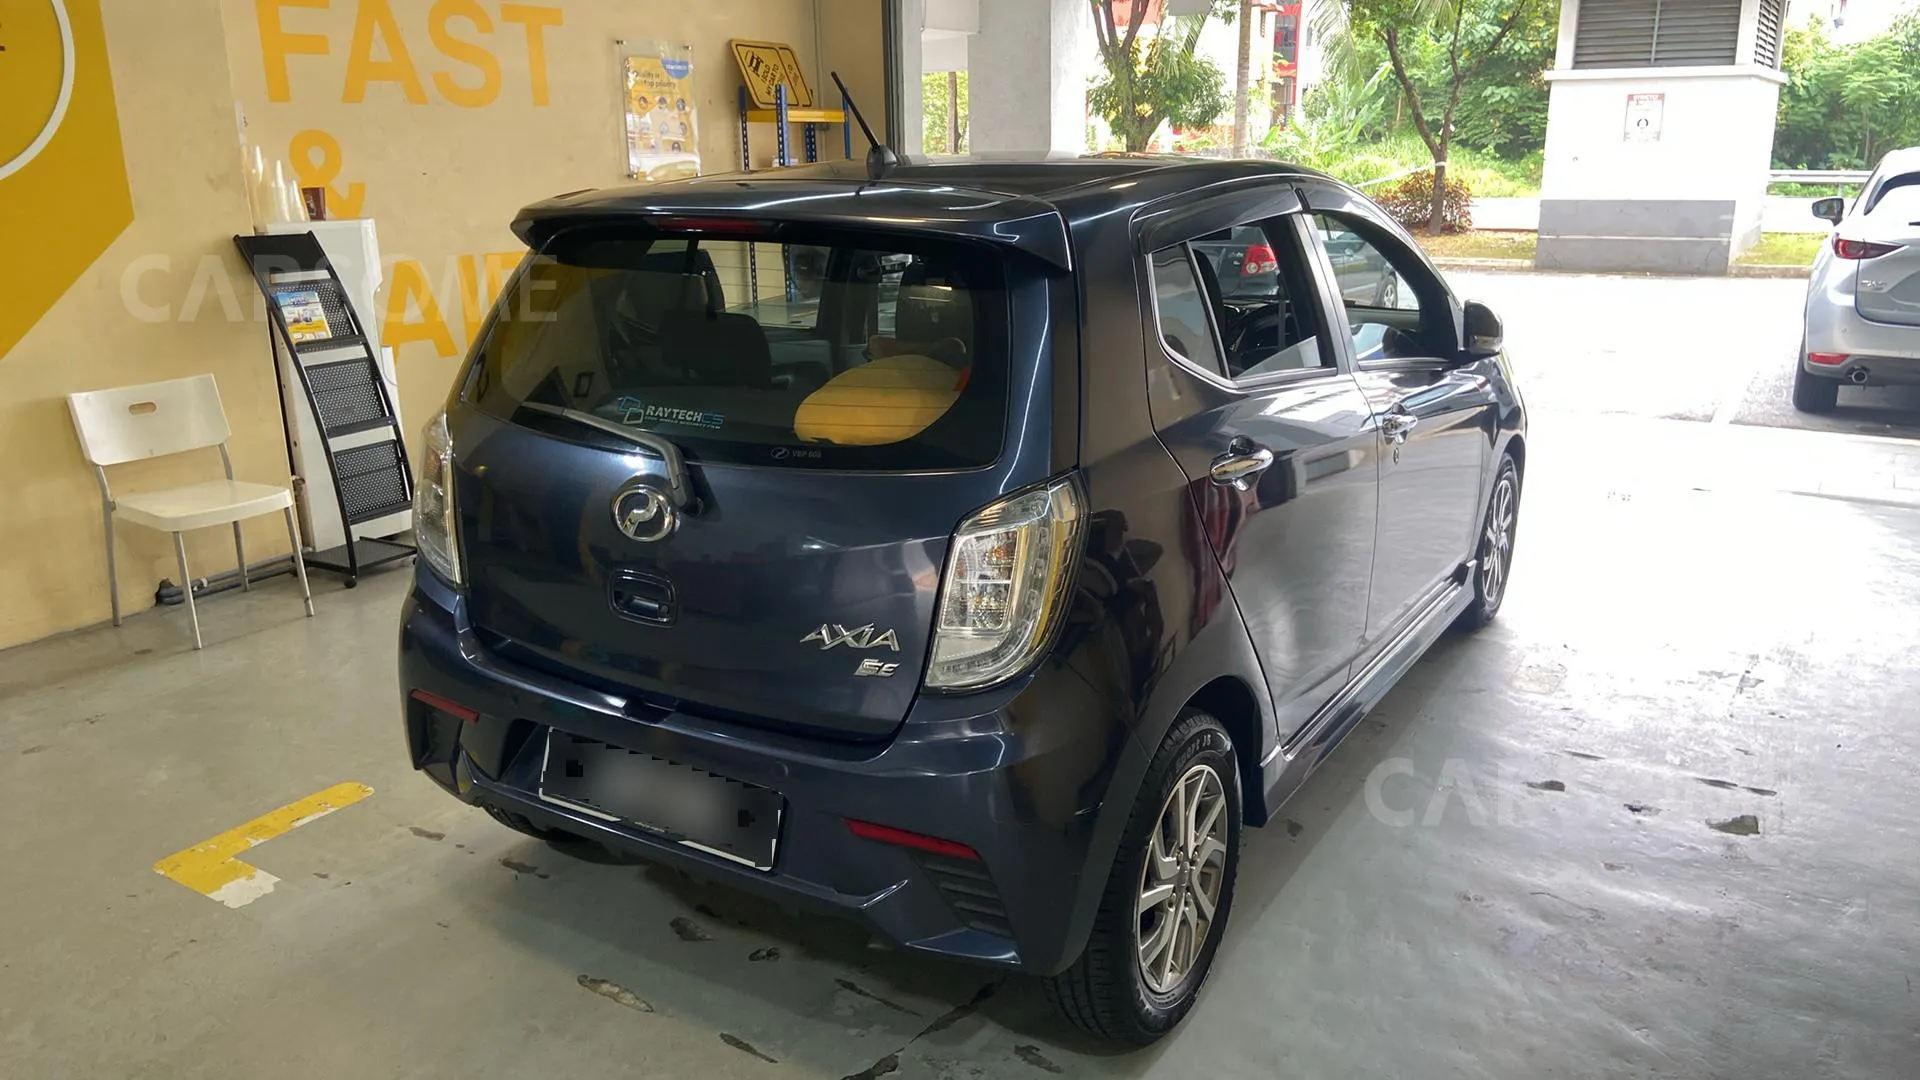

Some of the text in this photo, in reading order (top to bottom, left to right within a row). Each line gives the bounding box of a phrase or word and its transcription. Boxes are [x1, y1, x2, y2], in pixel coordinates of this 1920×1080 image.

[255, 0, 563, 108] FAST
[288, 129, 365, 219] &
[800, 623, 900, 652] AXIA
